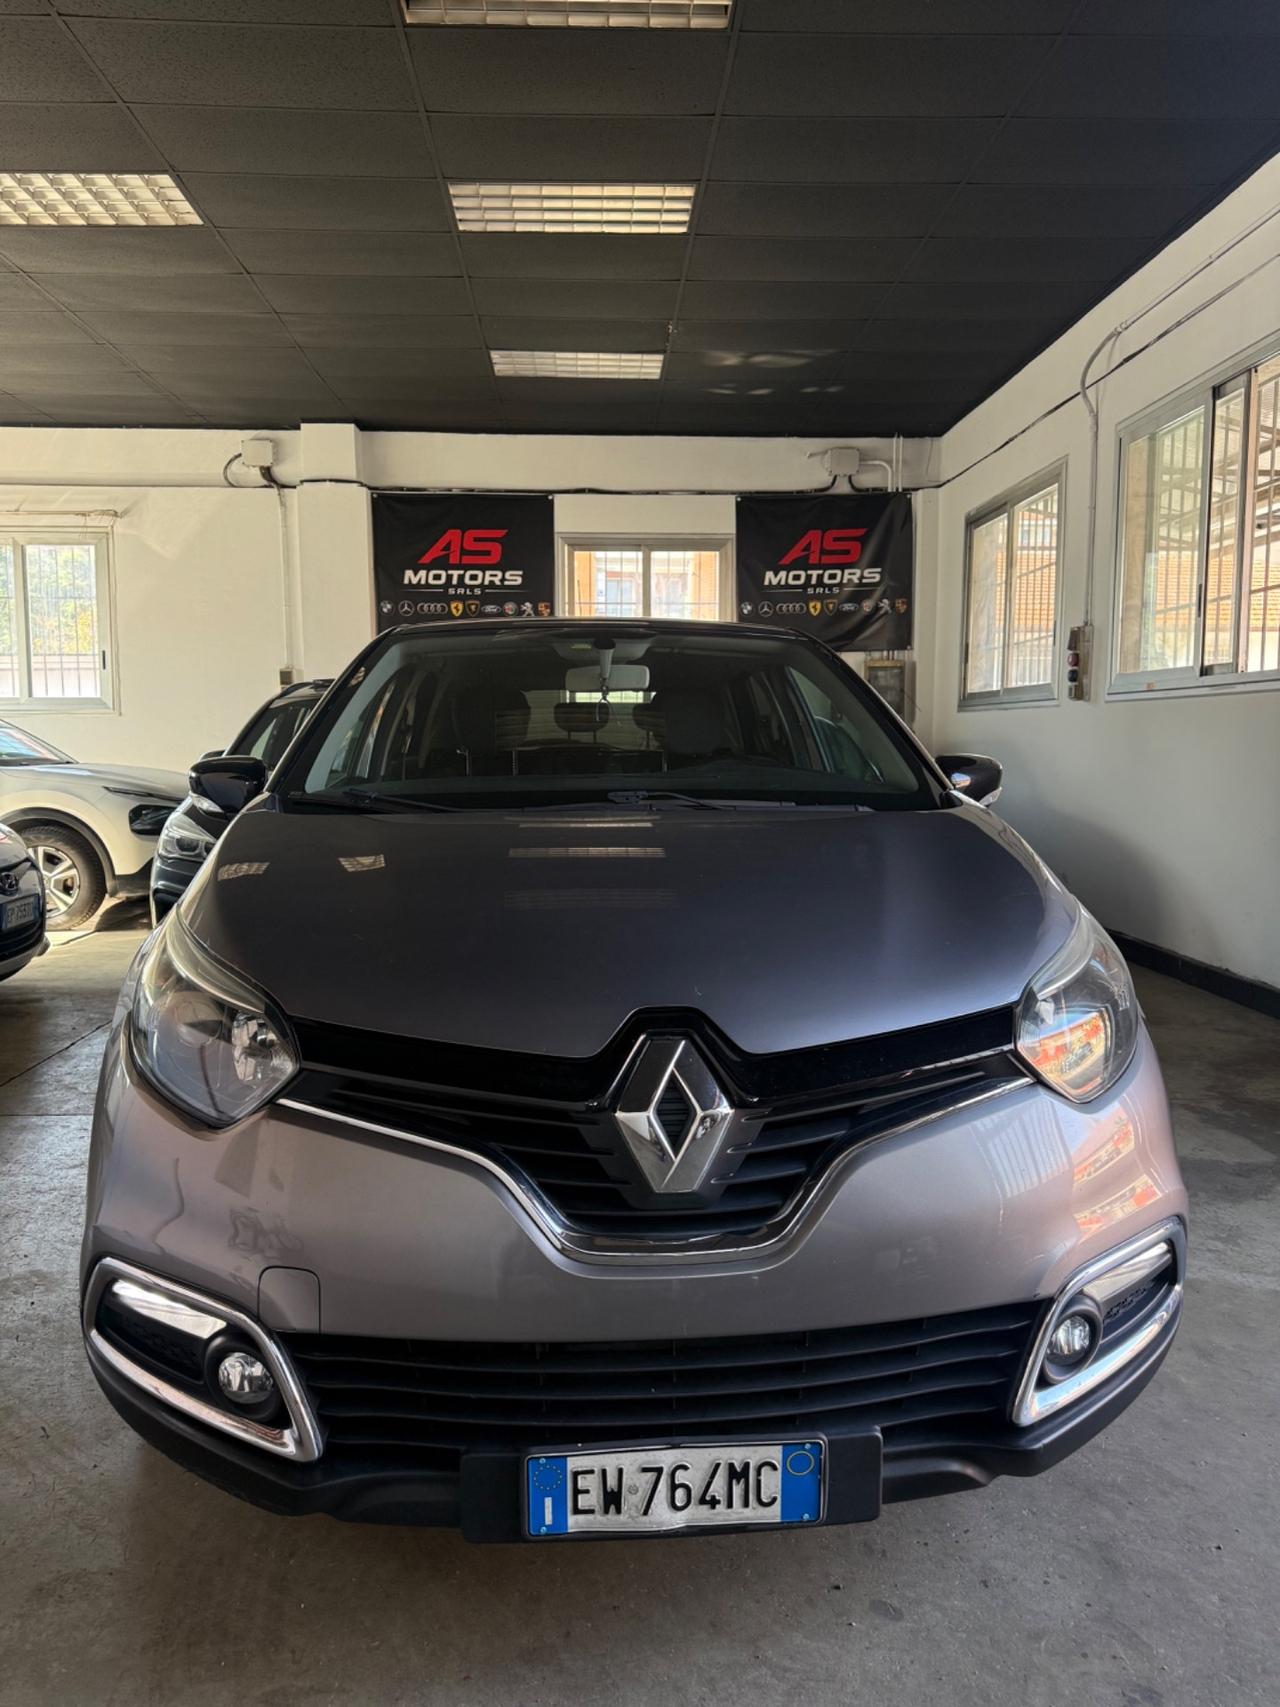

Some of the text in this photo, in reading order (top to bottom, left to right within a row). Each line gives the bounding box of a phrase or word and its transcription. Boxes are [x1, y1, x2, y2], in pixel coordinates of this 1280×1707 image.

[417, 529, 509, 564] AS
[778, 528, 868, 565] AS
[403, 570, 523, 586] MOTORS
[763, 568, 882, 586] MOTORS
[447, 587, 482, 595] SRLS
[806, 586, 840, 594] SRLS
